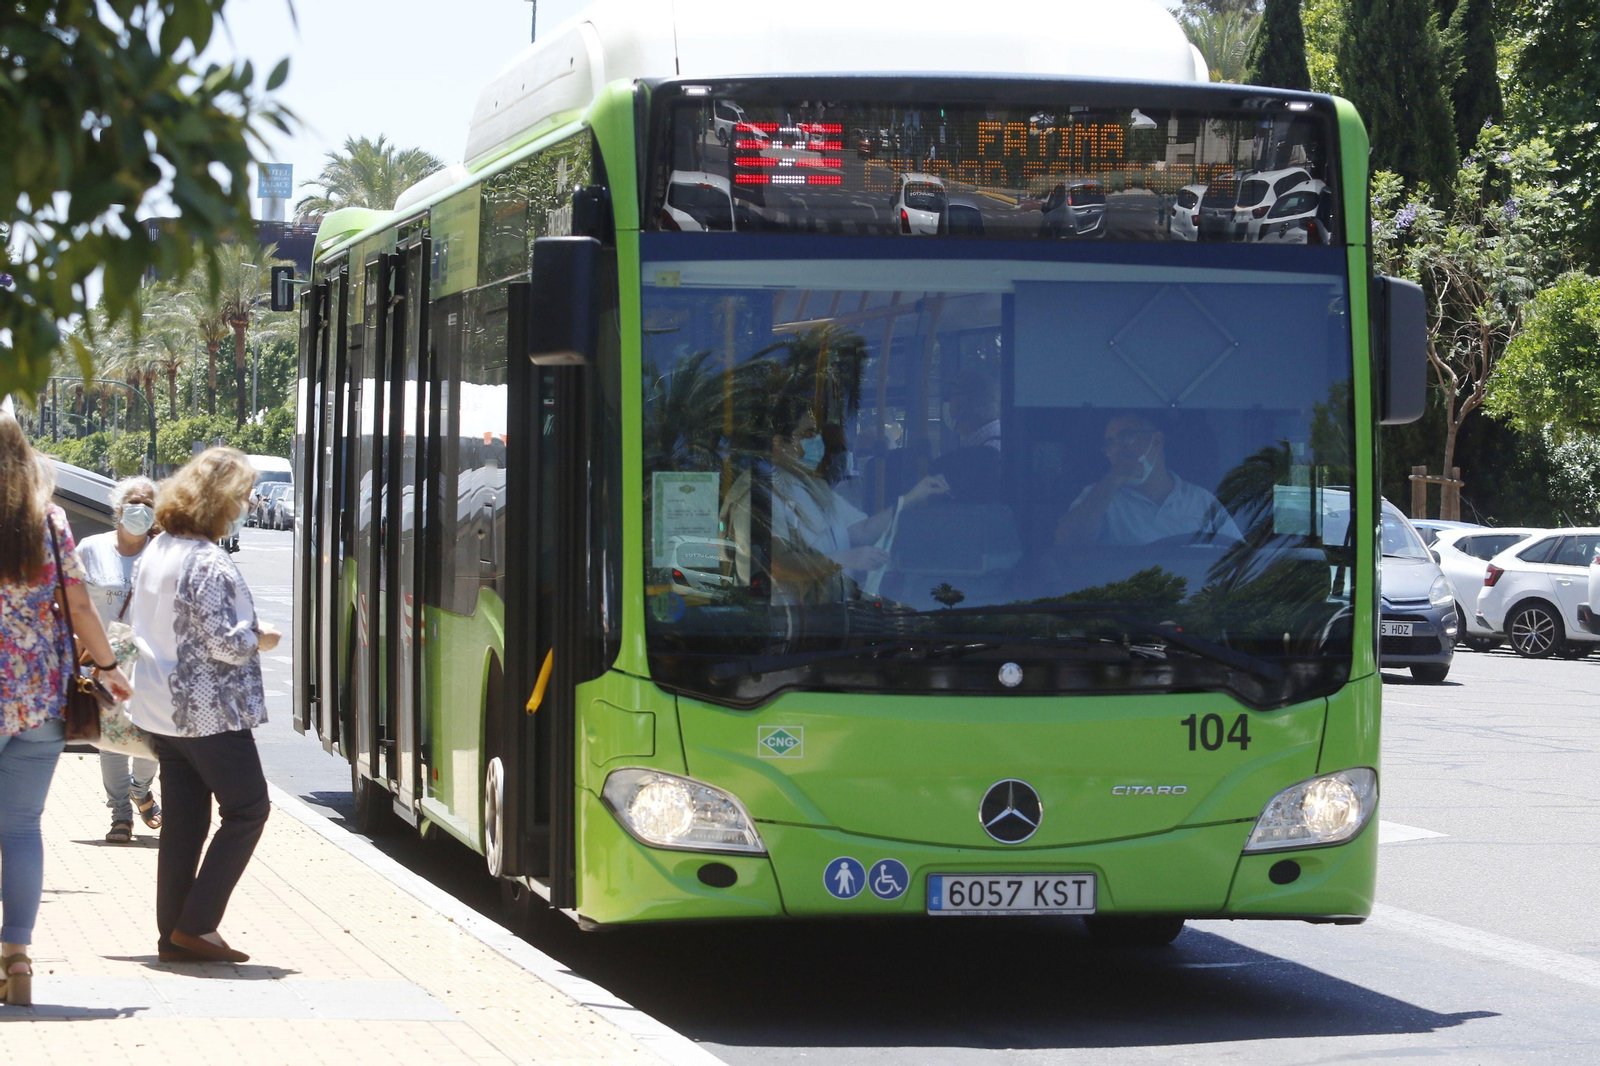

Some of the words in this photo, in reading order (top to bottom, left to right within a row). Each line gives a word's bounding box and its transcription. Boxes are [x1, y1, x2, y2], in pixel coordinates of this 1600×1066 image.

[978, 121, 1124, 158] FATIMA
[1391, 624, 1410, 635] HDZ
[1180, 712, 1252, 751] 104
[767, 737, 794, 747] CNG
[1111, 785, 1188, 796] CITARO
[949, 880, 1023, 907] 6057
[1033, 880, 1087, 907] KST
